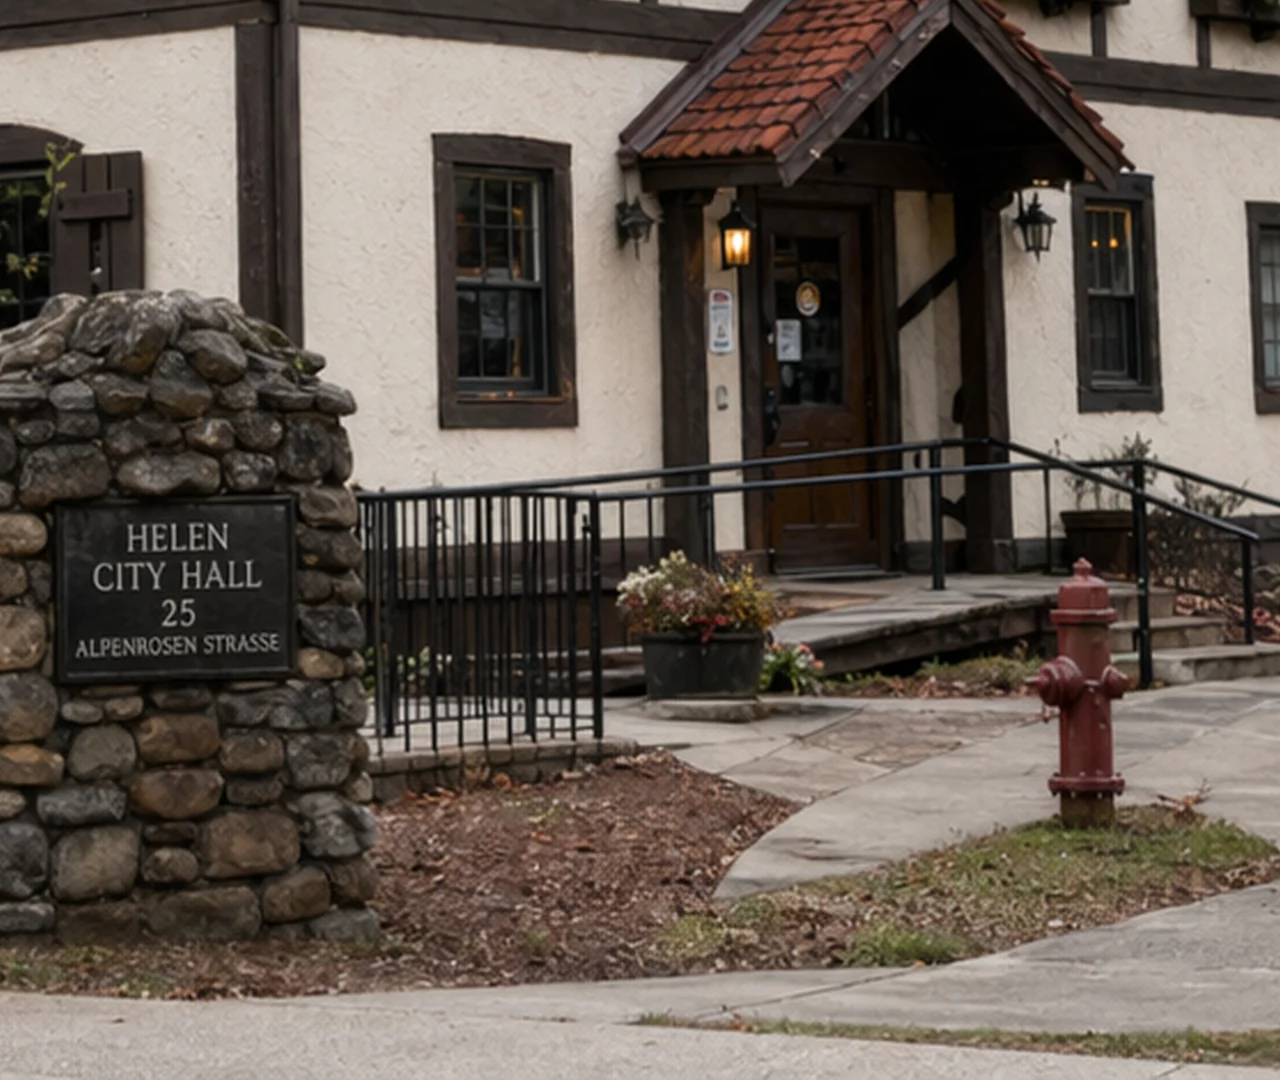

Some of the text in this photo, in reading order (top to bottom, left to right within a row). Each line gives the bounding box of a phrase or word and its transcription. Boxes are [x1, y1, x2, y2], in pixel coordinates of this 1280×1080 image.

[127, 522, 228, 552] HELEN
[92, 560, 262, 591] CITY HALL
[161, 599, 196, 627] 25
[75, 632, 280, 658] ALPENROSEN STRASSE
